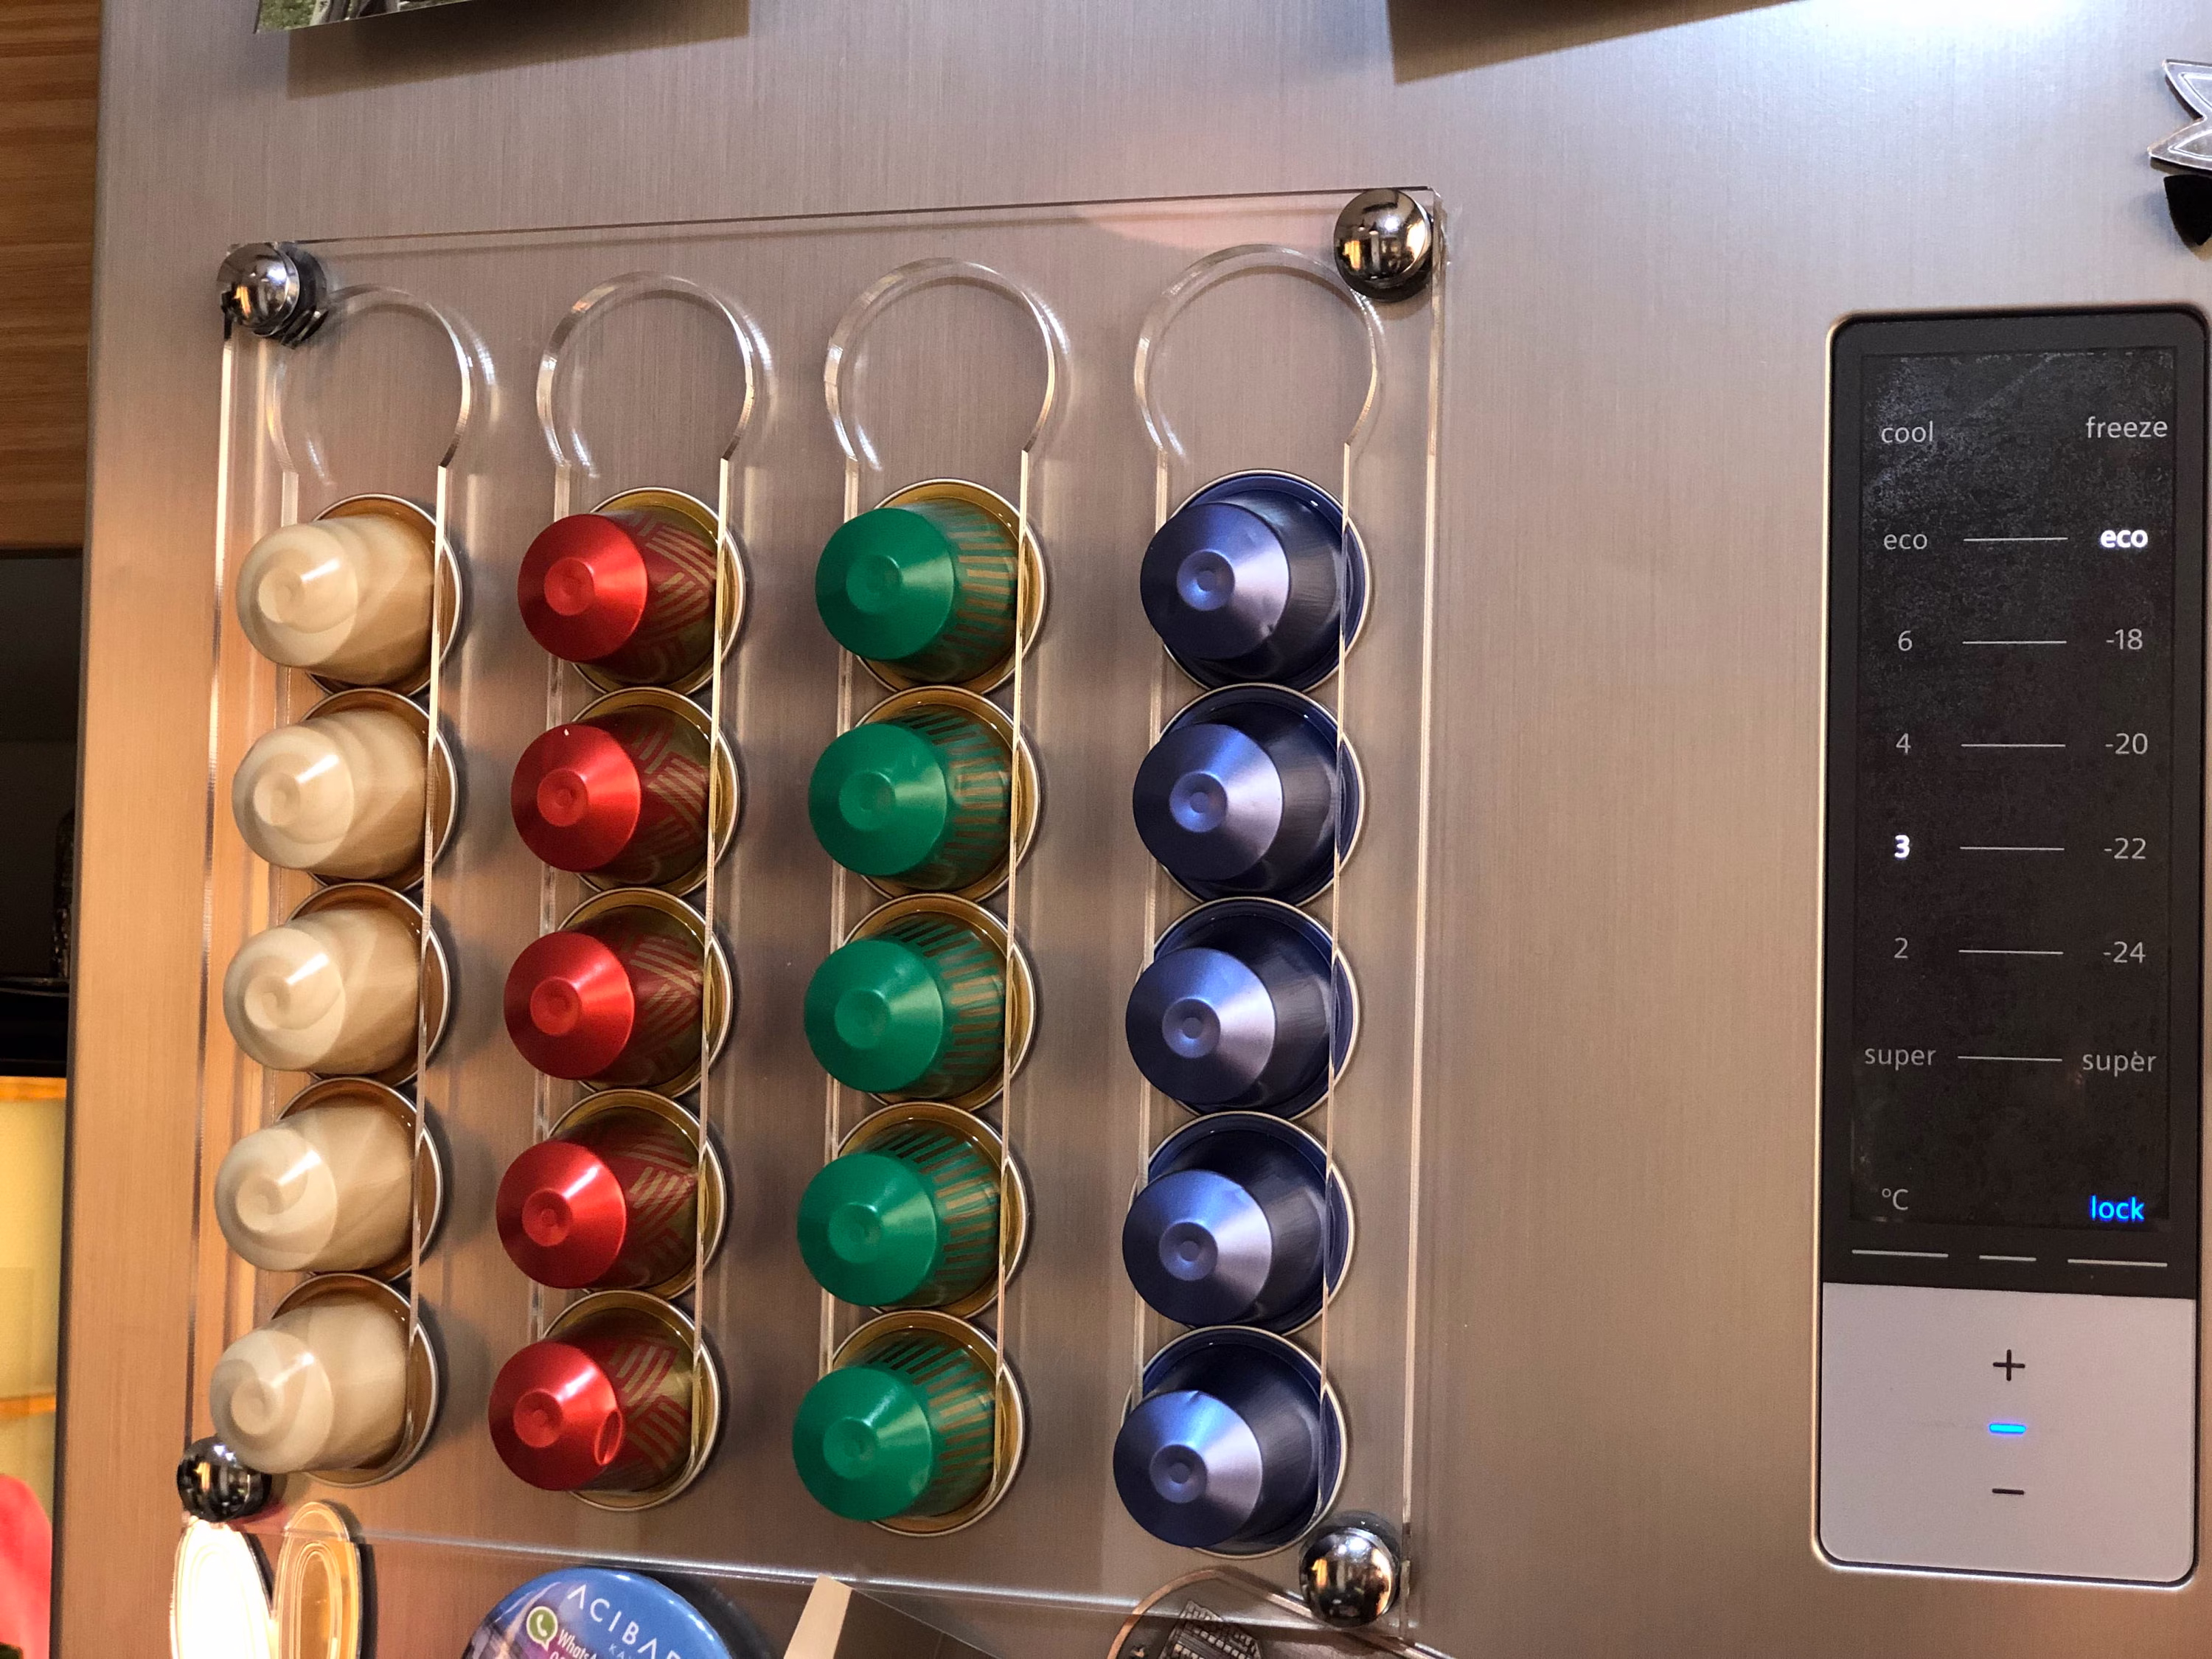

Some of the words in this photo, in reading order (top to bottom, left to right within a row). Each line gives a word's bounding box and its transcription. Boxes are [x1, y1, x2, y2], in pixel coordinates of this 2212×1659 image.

[1881, 420, 1934, 444] cool
[2085, 416, 2168, 439] freeze
[1882, 532, 1929, 550] eco
[2098, 529, 2149, 549] eco
[1897, 630, 1913, 652] 6
[2106, 628, 2143, 650] -18
[1895, 733, 1912, 755] 4
[2105, 733, 2149, 755] -20
[1894, 835, 1911, 860] 3
[2104, 838, 2147, 860] -22
[1893, 937, 1909, 959] 2
[2103, 941, 2146, 963] -24
[1864, 1048, 1936, 1071] super
[2081, 1053, 2157, 1077] super
[1881, 1189, 1909, 1211] °C
[2088, 1194, 2146, 1222] lock
